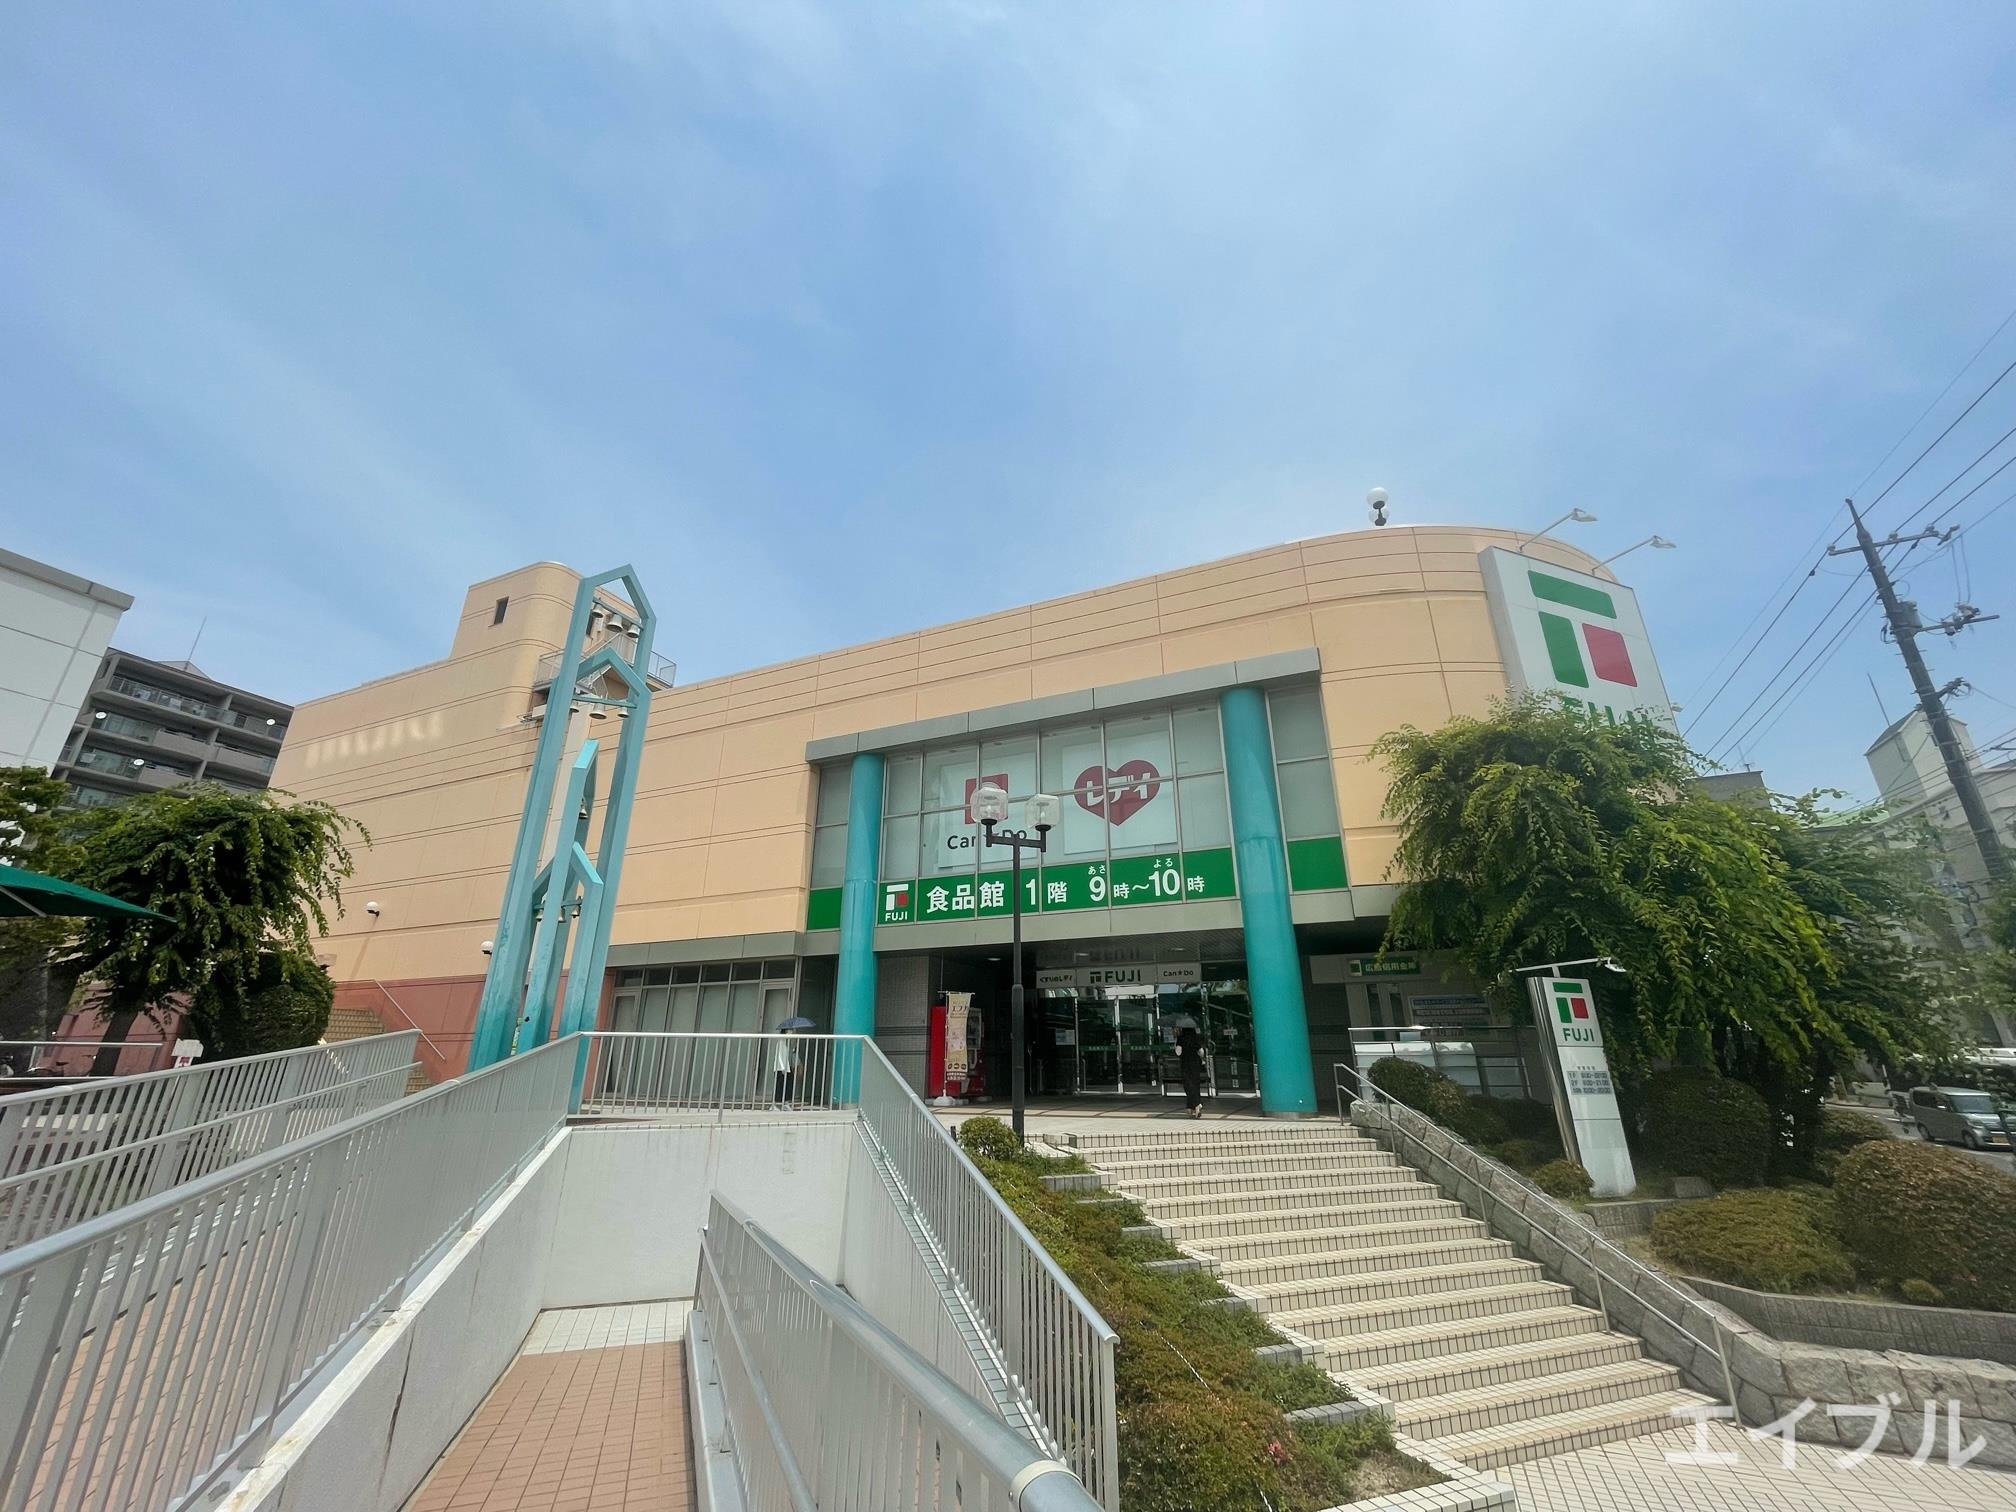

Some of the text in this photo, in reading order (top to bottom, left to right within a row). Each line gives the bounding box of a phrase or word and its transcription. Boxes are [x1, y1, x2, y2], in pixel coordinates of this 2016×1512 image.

[1153, 857, 1173, 868] よる
[1088, 864, 1106, 875] あさ
[926, 880, 1005, 914] 食品館
[1025, 878, 1068, 905] 1階
[885, 911, 908, 922] FUJI
[1104, 969, 1142, 983] FUJI
[1562, 1027, 1595, 1042] FUJI
